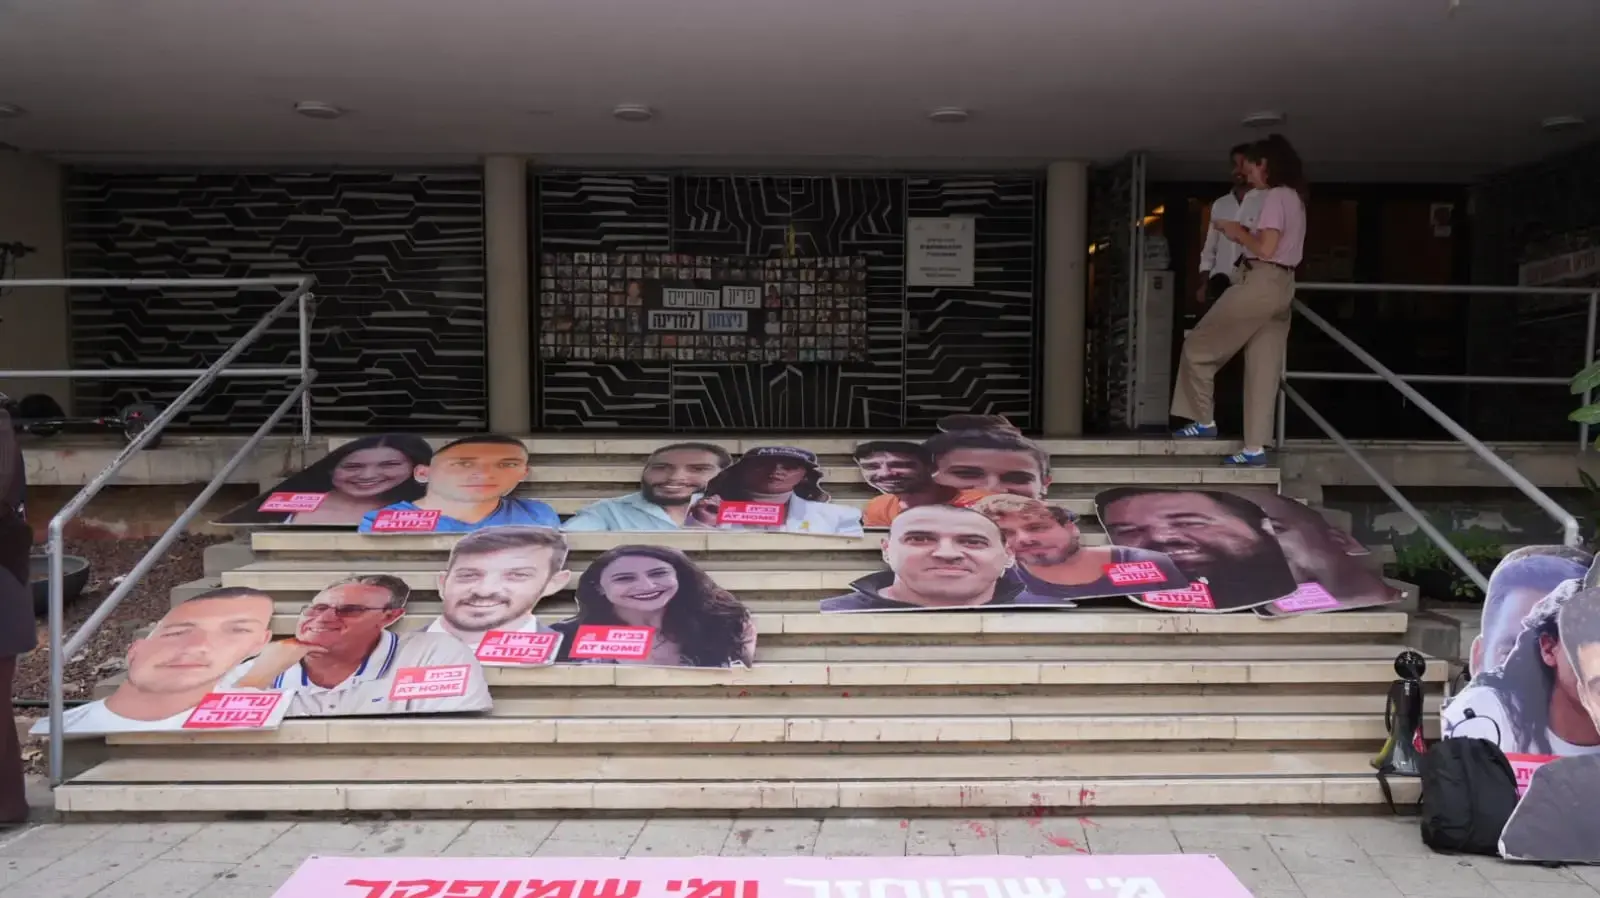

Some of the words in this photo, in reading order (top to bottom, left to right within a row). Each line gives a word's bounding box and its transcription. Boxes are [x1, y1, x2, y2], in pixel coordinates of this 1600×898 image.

[667, 290, 715, 307] השבויים
[728, 287, 756, 306] פדיון
[652, 310, 696, 329] למדינה
[707, 312, 744, 329] ניצחון
[741, 513, 777, 521] HOME
[502, 634, 550, 645] עדיין
[611, 632, 645, 640] בבית
[485, 646, 545, 658] בעזה.
[579, 643, 597, 651] AT
[600, 644, 642, 653] HOME
[428, 669, 465, 680] בבית
[397, 685, 417, 694] AT
[419, 682, 462, 693] HOME
[220, 695, 275, 709] עדיין
[199, 710, 266, 723] בעזה.
